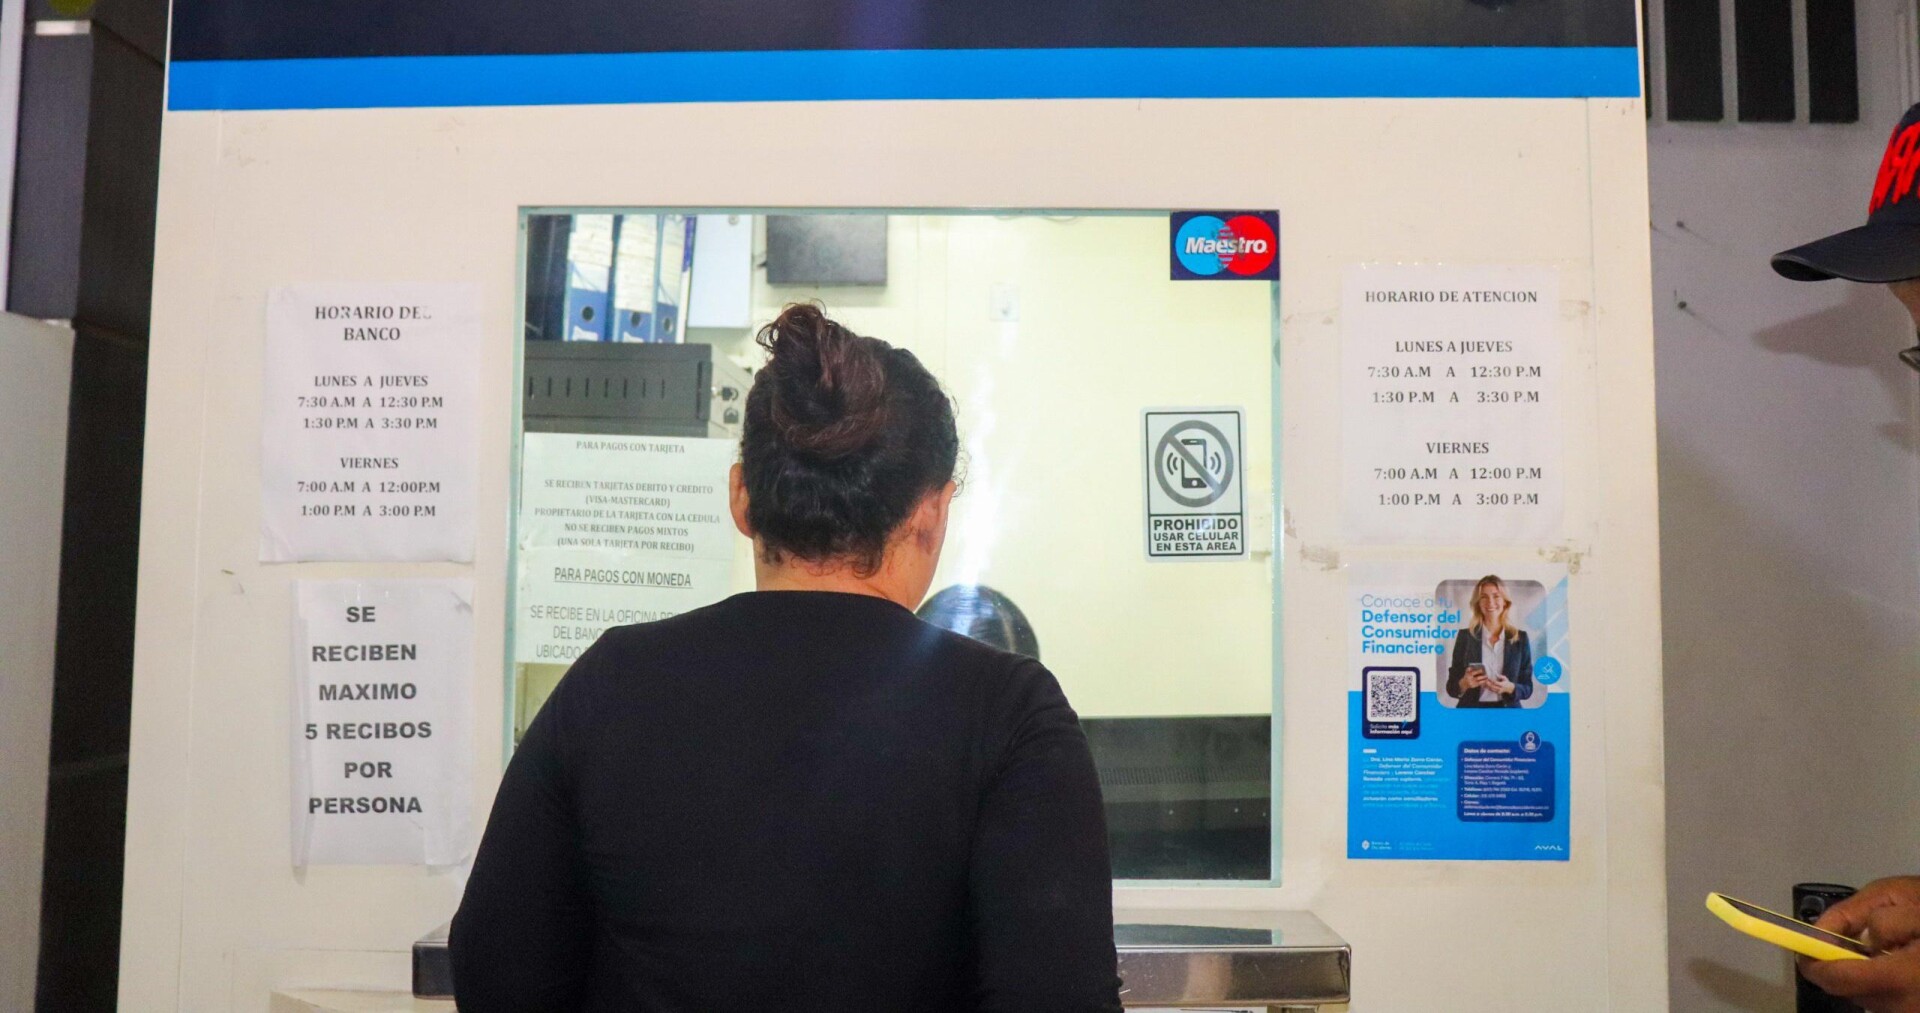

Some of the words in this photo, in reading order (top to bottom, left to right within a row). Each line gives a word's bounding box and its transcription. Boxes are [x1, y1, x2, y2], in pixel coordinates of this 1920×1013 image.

[1185, 237, 1267, 254] Maestro
[1365, 291, 1434, 302] HORARIO
[1439, 291, 1459, 302] DE
[1462, 291, 1537, 302] ATENCION
[315, 306, 394, 320] HORARIO
[343, 327, 400, 341] BANCO
[1395, 341, 1443, 352] LUNES
[1447, 341, 1456, 352] A
[1460, 341, 1513, 354] JUEVES
[1367, 366, 1400, 378] 7:30
[1404, 366, 1431, 378] A.M
[1446, 366, 1456, 378] A
[1471, 366, 1512, 378] 12:30
[1516, 366, 1542, 378] P.M
[314, 376, 357, 387] LUNES
[363, 376, 373, 387] A
[380, 376, 428, 389] JUEVES
[298, 396, 327, 408] 7:30
[330, 396, 355, 408] A.M
[362, 396, 372, 408] A
[380, 396, 417, 408] 12:30
[421, 396, 443, 408] P.M
[1373, 391, 1404, 403] 1:30
[1408, 391, 1435, 403] P.M
[1449, 391, 1459, 403] A
[1477, 391, 1509, 403] 3:30
[1514, 391, 1539, 403] P.M
[303, 417, 332, 429] 1:30
[336, 417, 358, 429] P.M
[365, 417, 374, 429] A
[381, 417, 411, 429] 3:30
[415, 417, 438, 429] P.M
[576, 441, 599, 450] PARA
[600, 441, 628, 451] PAGOS
[629, 442, 647, 452] CON
[649, 443, 685, 454] TARJETA
[1426, 442, 1490, 454] VIERNES
[340, 457, 399, 469] VIERNES
[1374, 468, 1406, 480] 7:00
[1410, 468, 1438, 480] A.M
[1449, 468, 1459, 480] A
[1471, 468, 1512, 480] 12:00
[1516, 468, 1542, 480] P.M
[297, 481, 327, 493] 7:00
[330, 481, 355, 493] A.M
[362, 481, 371, 493] A
[380, 481, 440, 493] 12:00P.M
[544, 479, 554, 488] SE
[556, 480, 591, 489] RECIBEN
[593, 481, 634, 491] TARJETAS
[636, 482, 668, 492] DEBITO
[669, 484, 675, 492] Y
[676, 484, 713, 494] CREDITO
[585, 495, 670, 508] (VISA-MASTERCARD)
[1379, 493, 1409, 506] 1:00
[1414, 493, 1441, 506] P.M
[1452, 493, 1462, 506] A
[1476, 493, 1508, 506] 3:00
[1513, 493, 1539, 506] P.M
[301, 505, 330, 517] 1:00
[333, 505, 355, 517] P.M
[363, 505, 372, 517] A
[379, 505, 410, 517] 3:00
[414, 505, 436, 517] P.M
[534, 507, 591, 518] PROPIETARIO
[593, 510, 605, 518] DE
[606, 510, 616, 519] LA
[618, 510, 654, 521] TARJETA
[656, 512, 673, 521] CON
[675, 513, 685, 522] LA
[687, 513, 720, 523] CEDULA
[564, 523, 577, 531] NO
[579, 523, 589, 532] SE
[590, 524, 625, 534] RECIBEN
[628, 525, 655, 535] PAGOS
[657, 527, 688, 537] MIXTOS
[1153, 532, 1184, 542] USAR
[1188, 531, 1239, 541] CELULAR
[558, 537, 578, 547] (UNA
[580, 538, 601, 547] SOLA
[604, 539, 639, 549] TARJETA
[641, 541, 658, 550] POR
[660, 542, 694, 553] RECIBO)
[1156, 543, 1171, 551] EN
[1175, 542, 1203, 551] ESTA
[1207, 541, 1237, 550] AREA
[554, 567, 581, 581] PARA
[584, 568, 619, 583] PAGOS
[622, 570, 645, 584] CON
[647, 572, 692, 586] MONEDA
[1361, 594, 1420, 608] Conoce
[1425, 598, 1434, 608] a
[346, 606, 376, 623] SE
[530, 605, 544, 619] SE
[546, 606, 583, 621] RECIBE
[586, 608, 600, 622] EN
[602, 609, 615, 622] LA
[617, 609, 657, 624] OFICINA
[1362, 609, 1433, 623] Defensor
[1437, 610, 1460, 623] del
[553, 625, 572, 640] DEL
[1362, 625, 1457, 638] Consumidor
[312, 644, 417, 662] RECIBEN
[536, 644, 581, 659] UBICADO
[1362, 640, 1445, 655] Financiero
[319, 682, 417, 701] MAXIMO
[305, 723, 318, 740] 5
[326, 721, 432, 740] RECIBOS
[344, 761, 393, 778] POR
[309, 796, 422, 814] PERSONA
